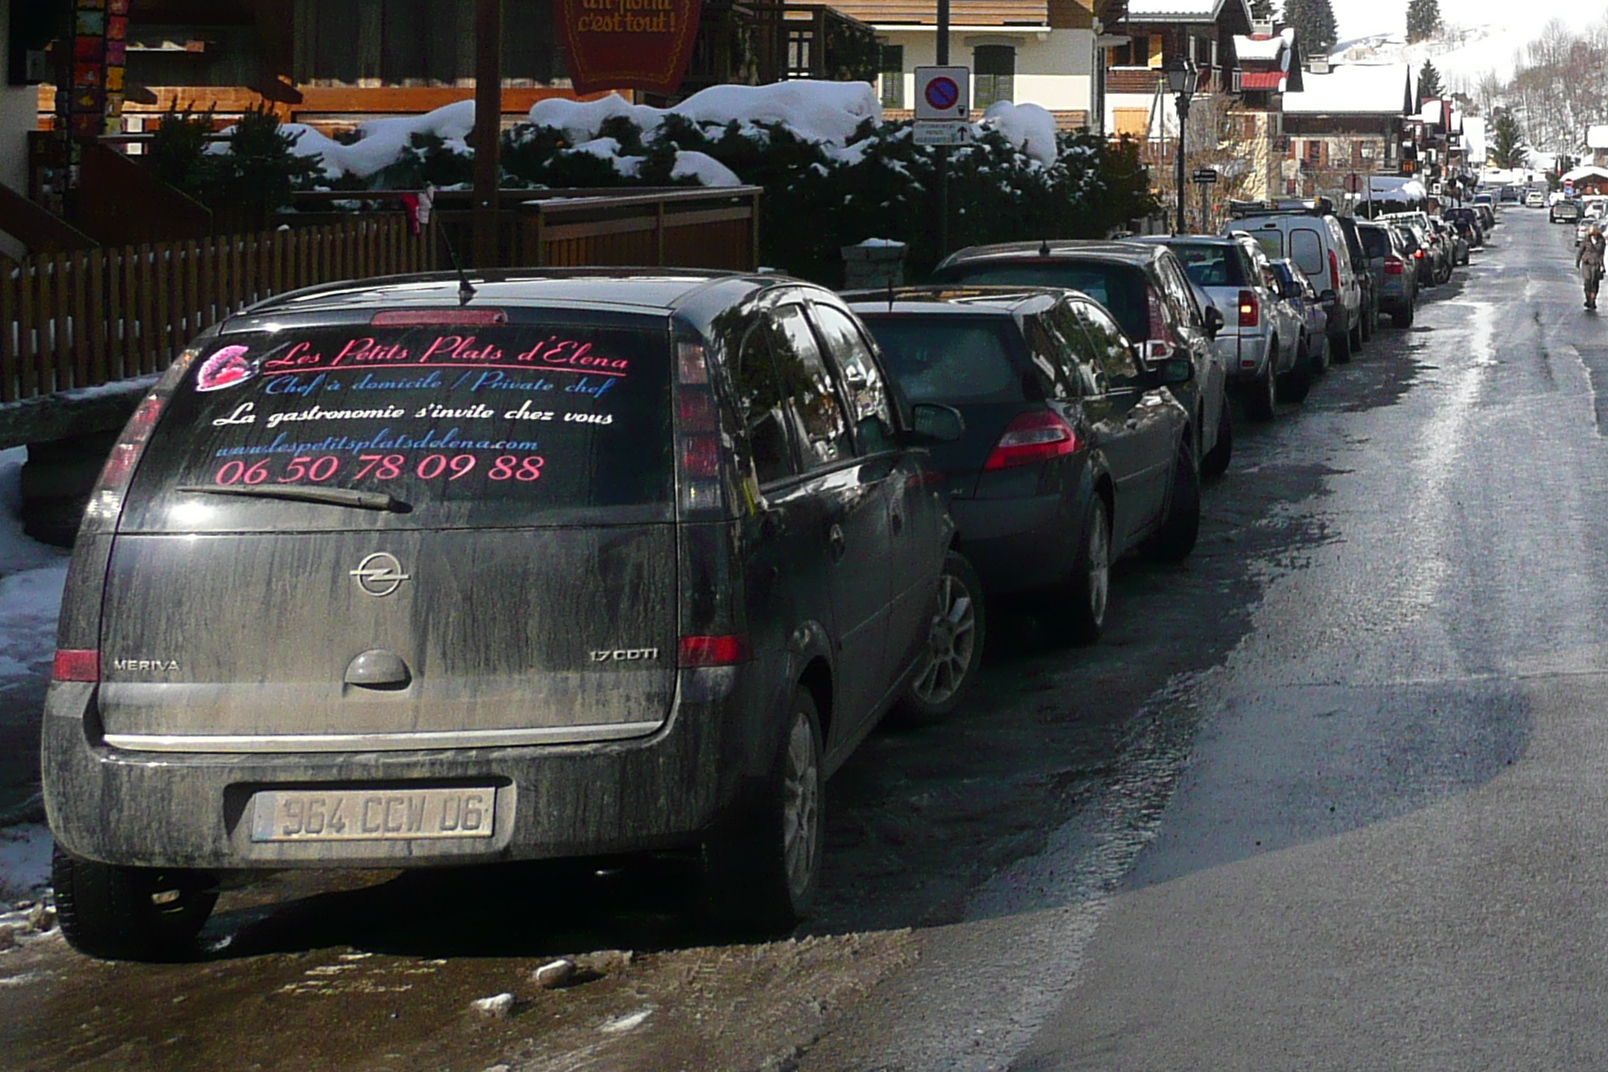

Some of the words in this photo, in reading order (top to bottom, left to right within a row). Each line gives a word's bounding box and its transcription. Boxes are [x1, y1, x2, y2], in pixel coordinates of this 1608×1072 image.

[577, 12, 622, 32] c'est
[265, 342, 321, 368] Les
[331, 337, 408, 365] Petits
[419, 335, 503, 363] Plats
[518, 335, 628, 369] d'Elena
[265, 374, 326, 396] Chef
[327, 380, 340, 391] à
[352, 371, 441, 390] domicile
[471, 371, 554, 392] Private
[565, 377, 616, 398] chef
[212, 402, 256, 426] La
[267, 405, 405, 428] gastronomie
[415, 403, 494, 419] s'invite
[504, 400, 554, 420] chez
[564, 412, 613, 425] vous
[215, 458, 271, 486] 06
[277, 456, 339, 483] 50
[353, 454, 405, 480] 78
[416, 454, 476, 481] 09
[488, 455, 545, 481] 88
[114, 659, 179, 671] MERIVA
[612, 647, 659, 660] CDTI
[281, 797, 346, 836] 964
[361, 794, 426, 833] CCW
[439, 794, 483, 832] 06
